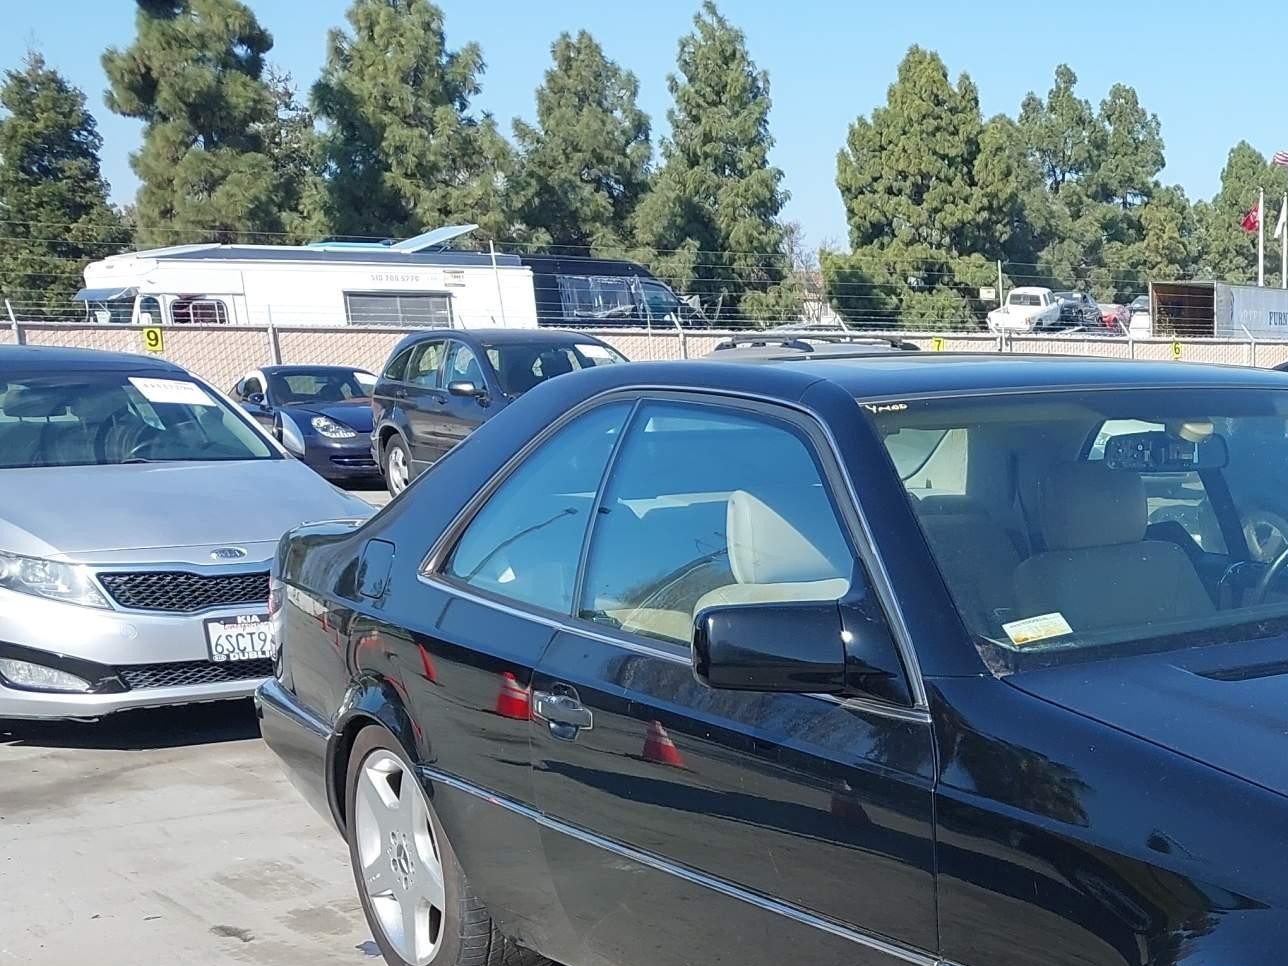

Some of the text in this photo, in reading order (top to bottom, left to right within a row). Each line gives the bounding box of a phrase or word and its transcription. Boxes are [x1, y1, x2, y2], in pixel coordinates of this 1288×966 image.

[146, 329, 159, 347] 9
[934, 339, 942, 351] 7
[1174, 342, 1180, 355] 6
[237, 615, 260, 624] KIA
[215, 632, 267, 654] 6SCT9
